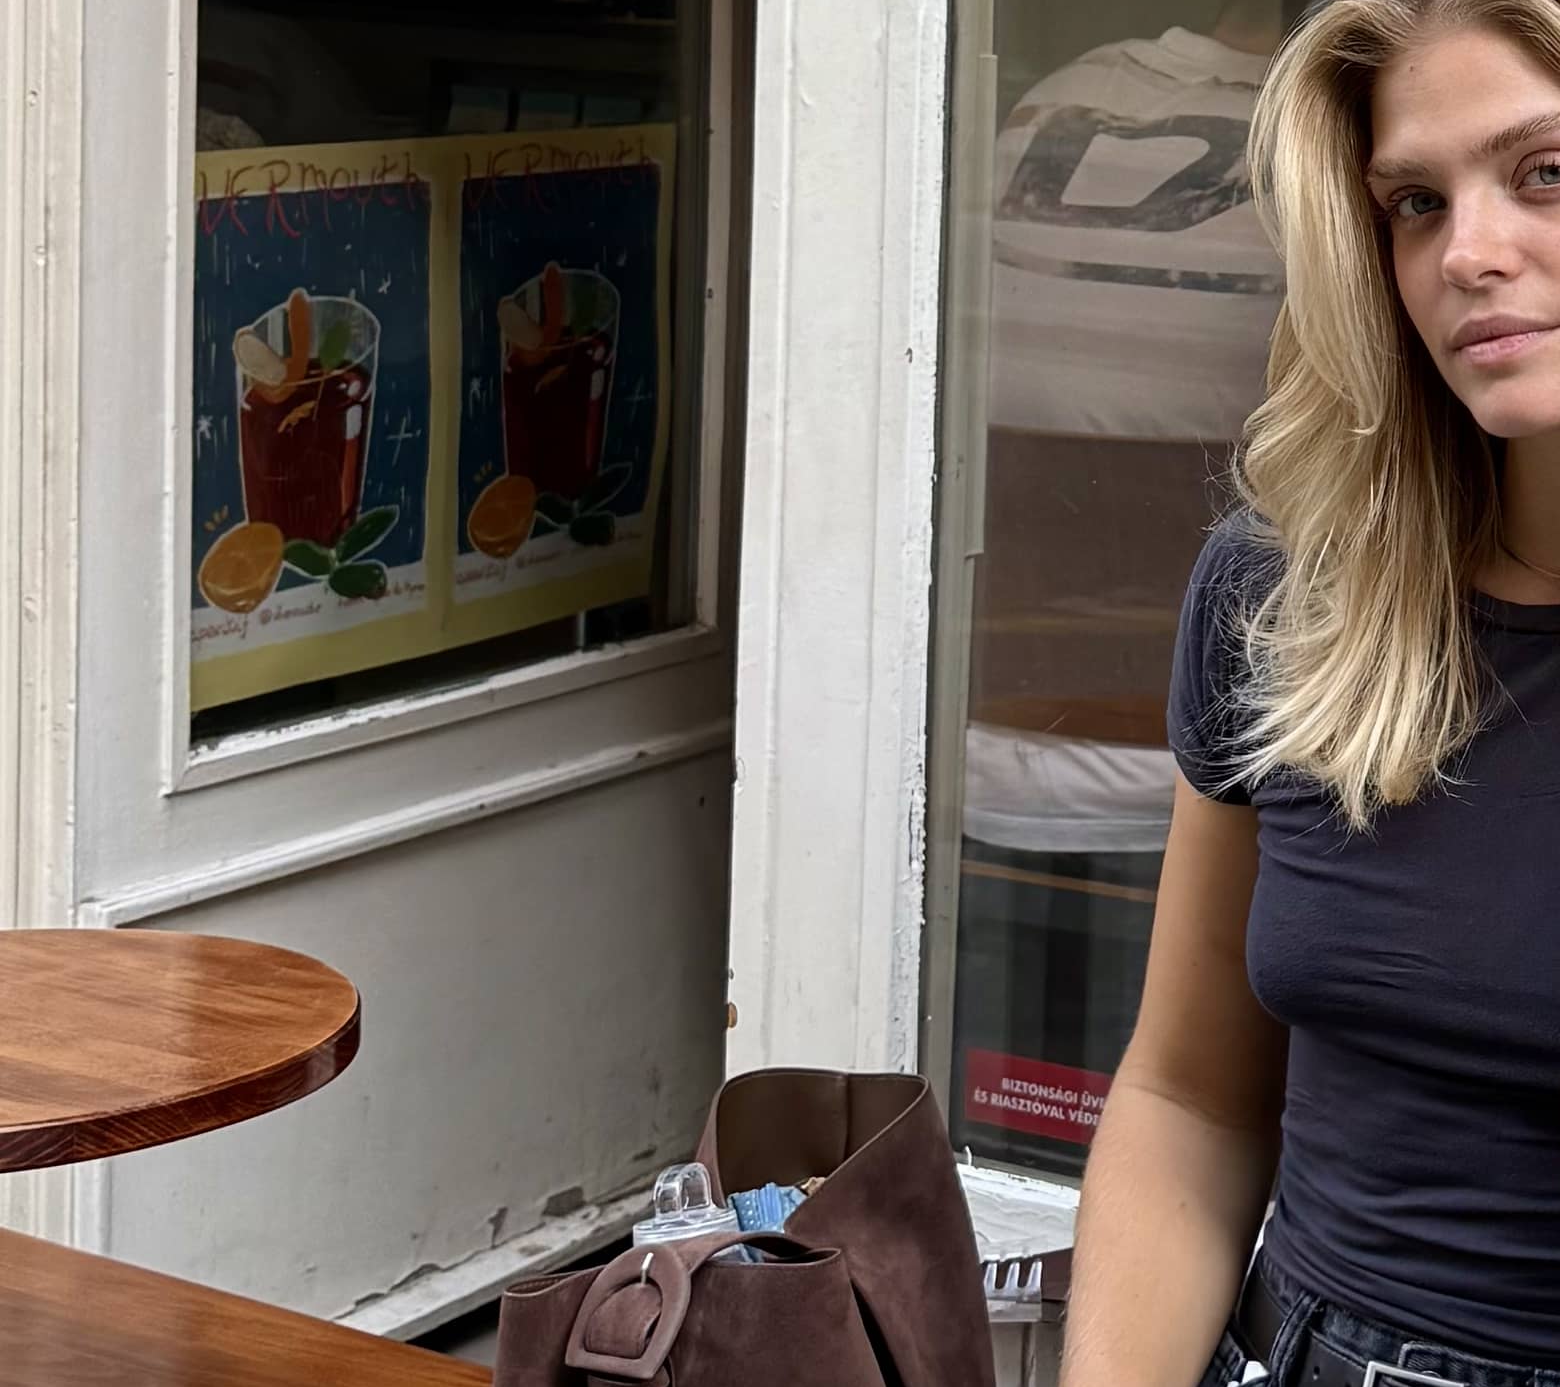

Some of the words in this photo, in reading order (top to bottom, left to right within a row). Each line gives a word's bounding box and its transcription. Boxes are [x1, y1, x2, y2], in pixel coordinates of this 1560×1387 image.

[973, 1085, 988, 1103] ÉS
[990, 1091, 1065, 1121] RIASZTÓVAL
[1001, 1077, 1079, 1104] BIZTONSÁGI
